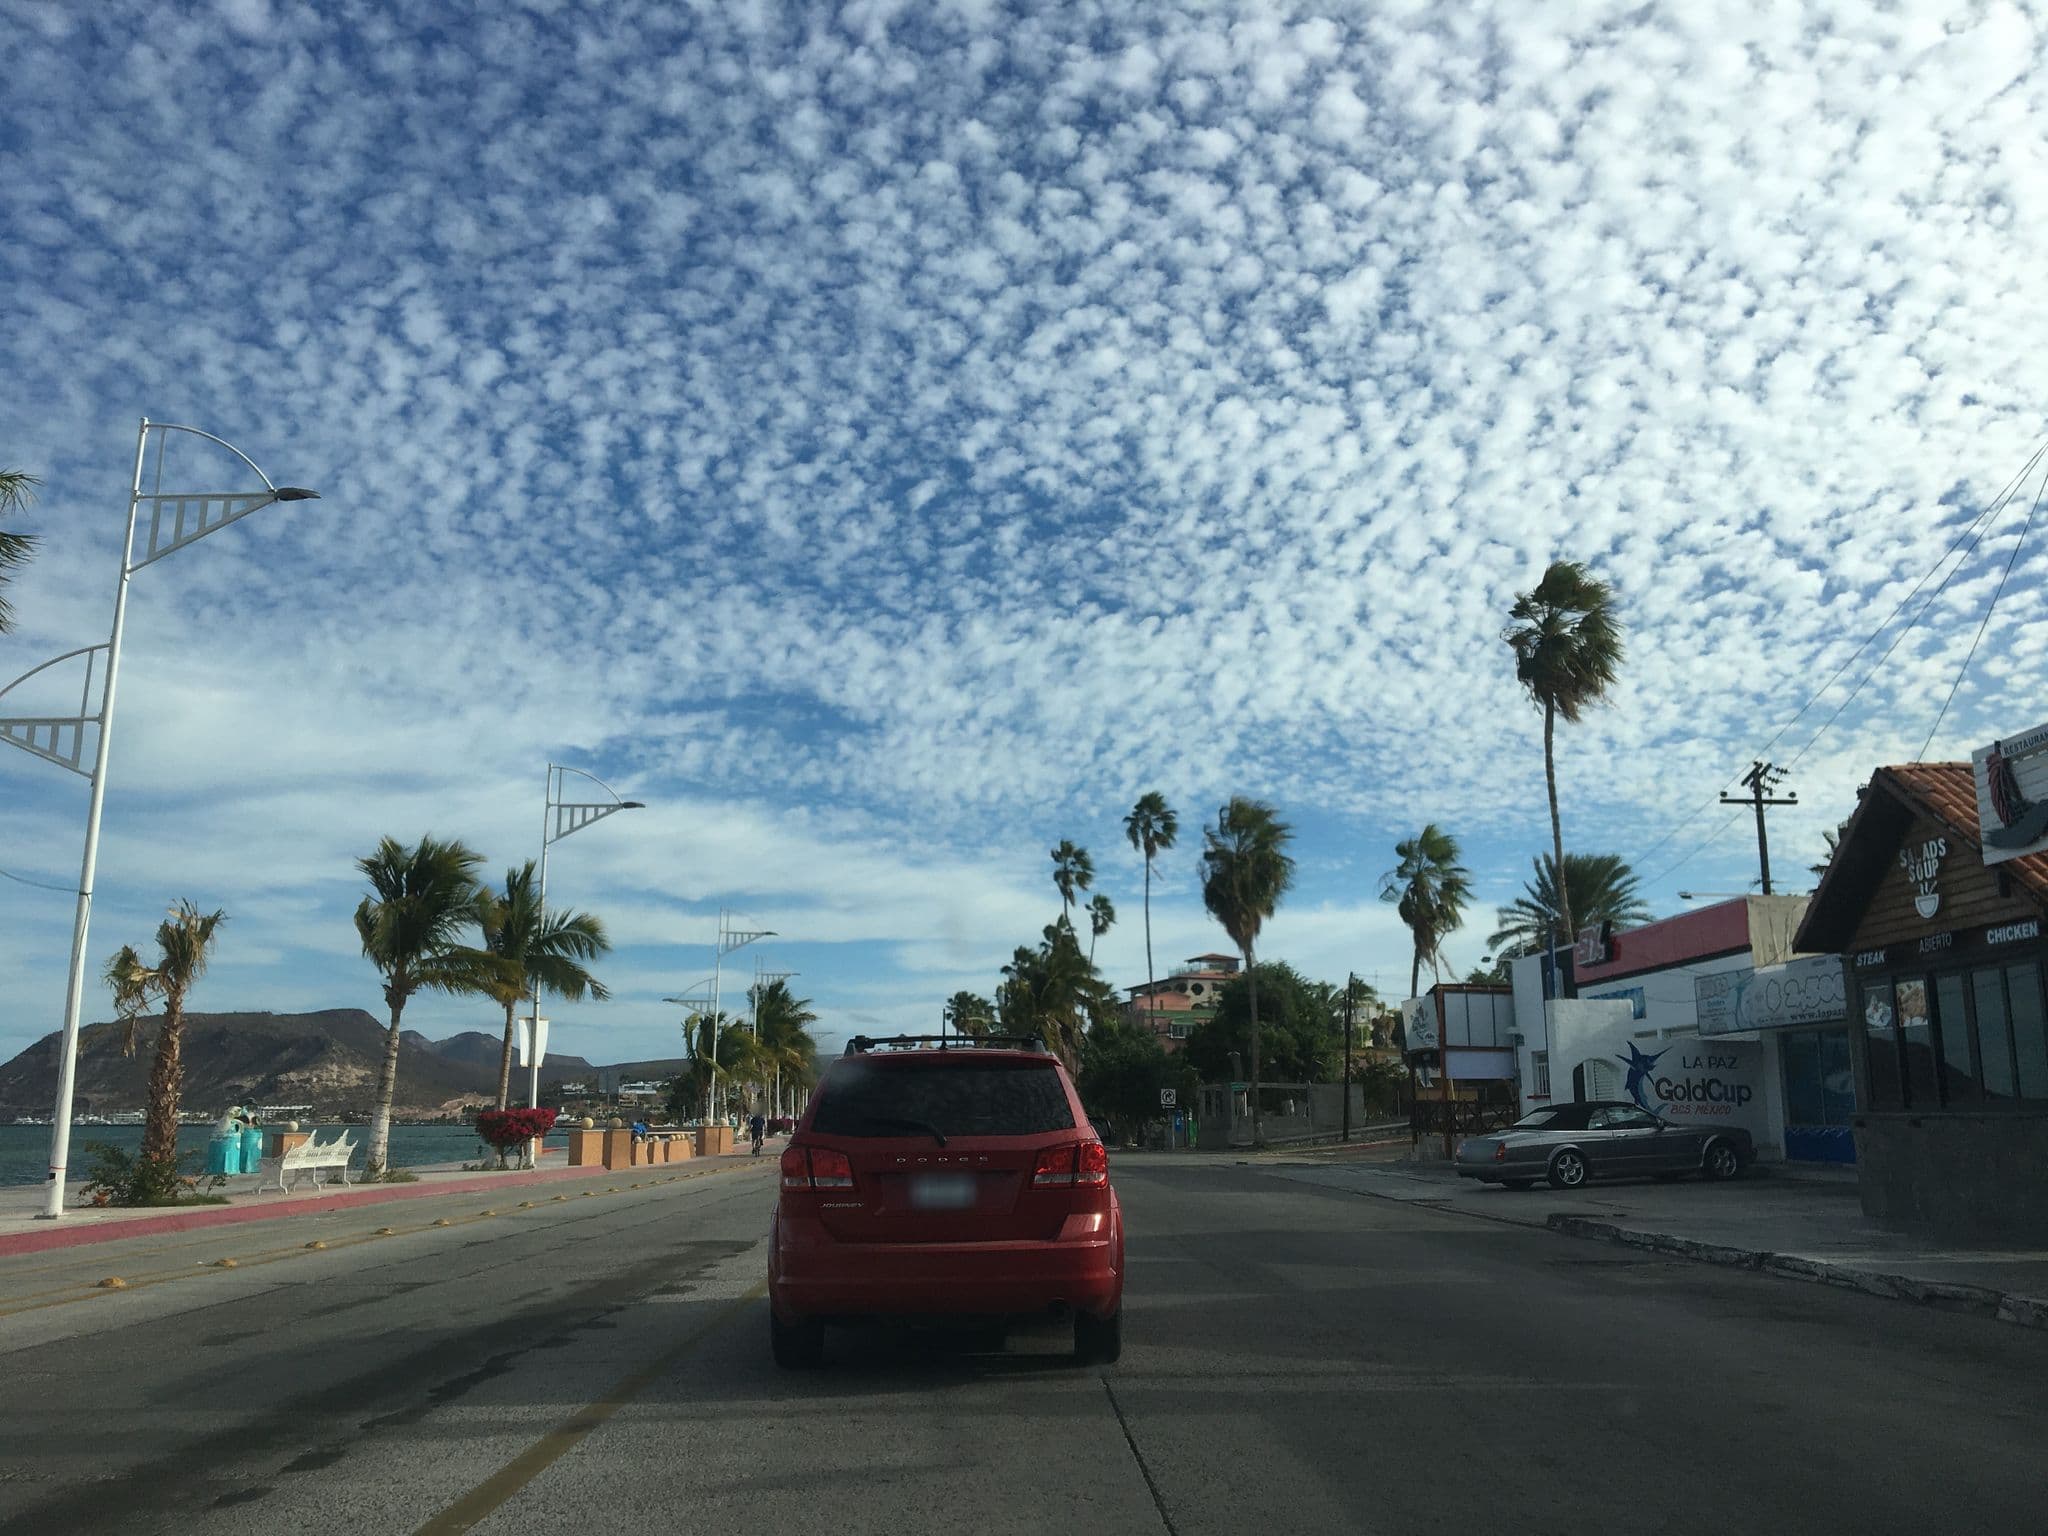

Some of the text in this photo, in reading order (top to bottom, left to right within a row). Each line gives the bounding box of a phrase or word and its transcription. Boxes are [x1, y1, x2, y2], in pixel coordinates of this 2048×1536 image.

[1908, 858, 1940, 883] SOUP
[1918, 932, 1953, 953] ABIERTO
[1986, 921, 2039, 944] CHICKEN
[1855, 951, 1886, 967] STEAK
[1682, 1056, 1738, 1069] LA PAZ
[1655, 1077, 1752, 1106] GoldCup
[1670, 1104, 1690, 1115] BCS
